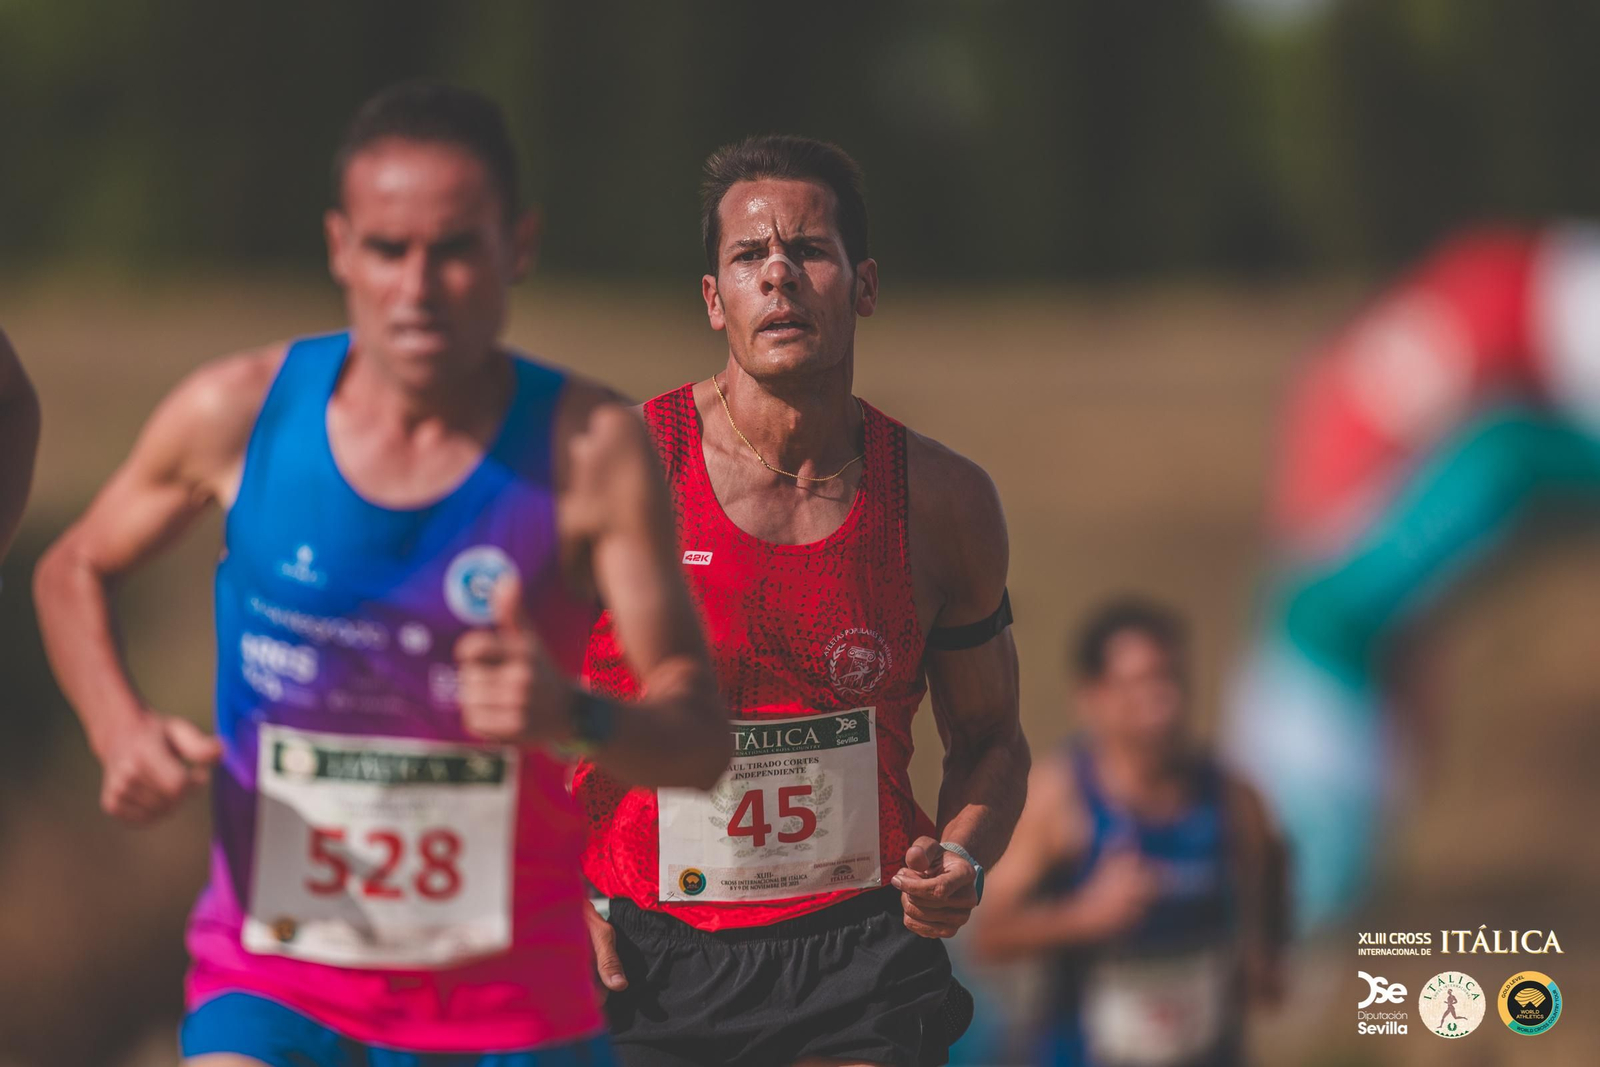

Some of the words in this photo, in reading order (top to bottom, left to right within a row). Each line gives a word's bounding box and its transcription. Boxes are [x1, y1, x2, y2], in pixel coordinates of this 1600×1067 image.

[685, 553, 710, 562] 42K
[823, 632, 845, 657] ATLETAS
[730, 727, 821, 751] TÁLICA
[836, 736, 859, 746] Sevilla
[728, 763, 746, 772] AUL
[747, 760, 782, 770] TIRADO
[783, 756, 820, 766] CORTES
[735, 766, 807, 781] INDEPENDIENTE
[727, 785, 817, 847] 45
[303, 825, 464, 903] 528
[738, 877, 779, 886] INTERNACIONAL
